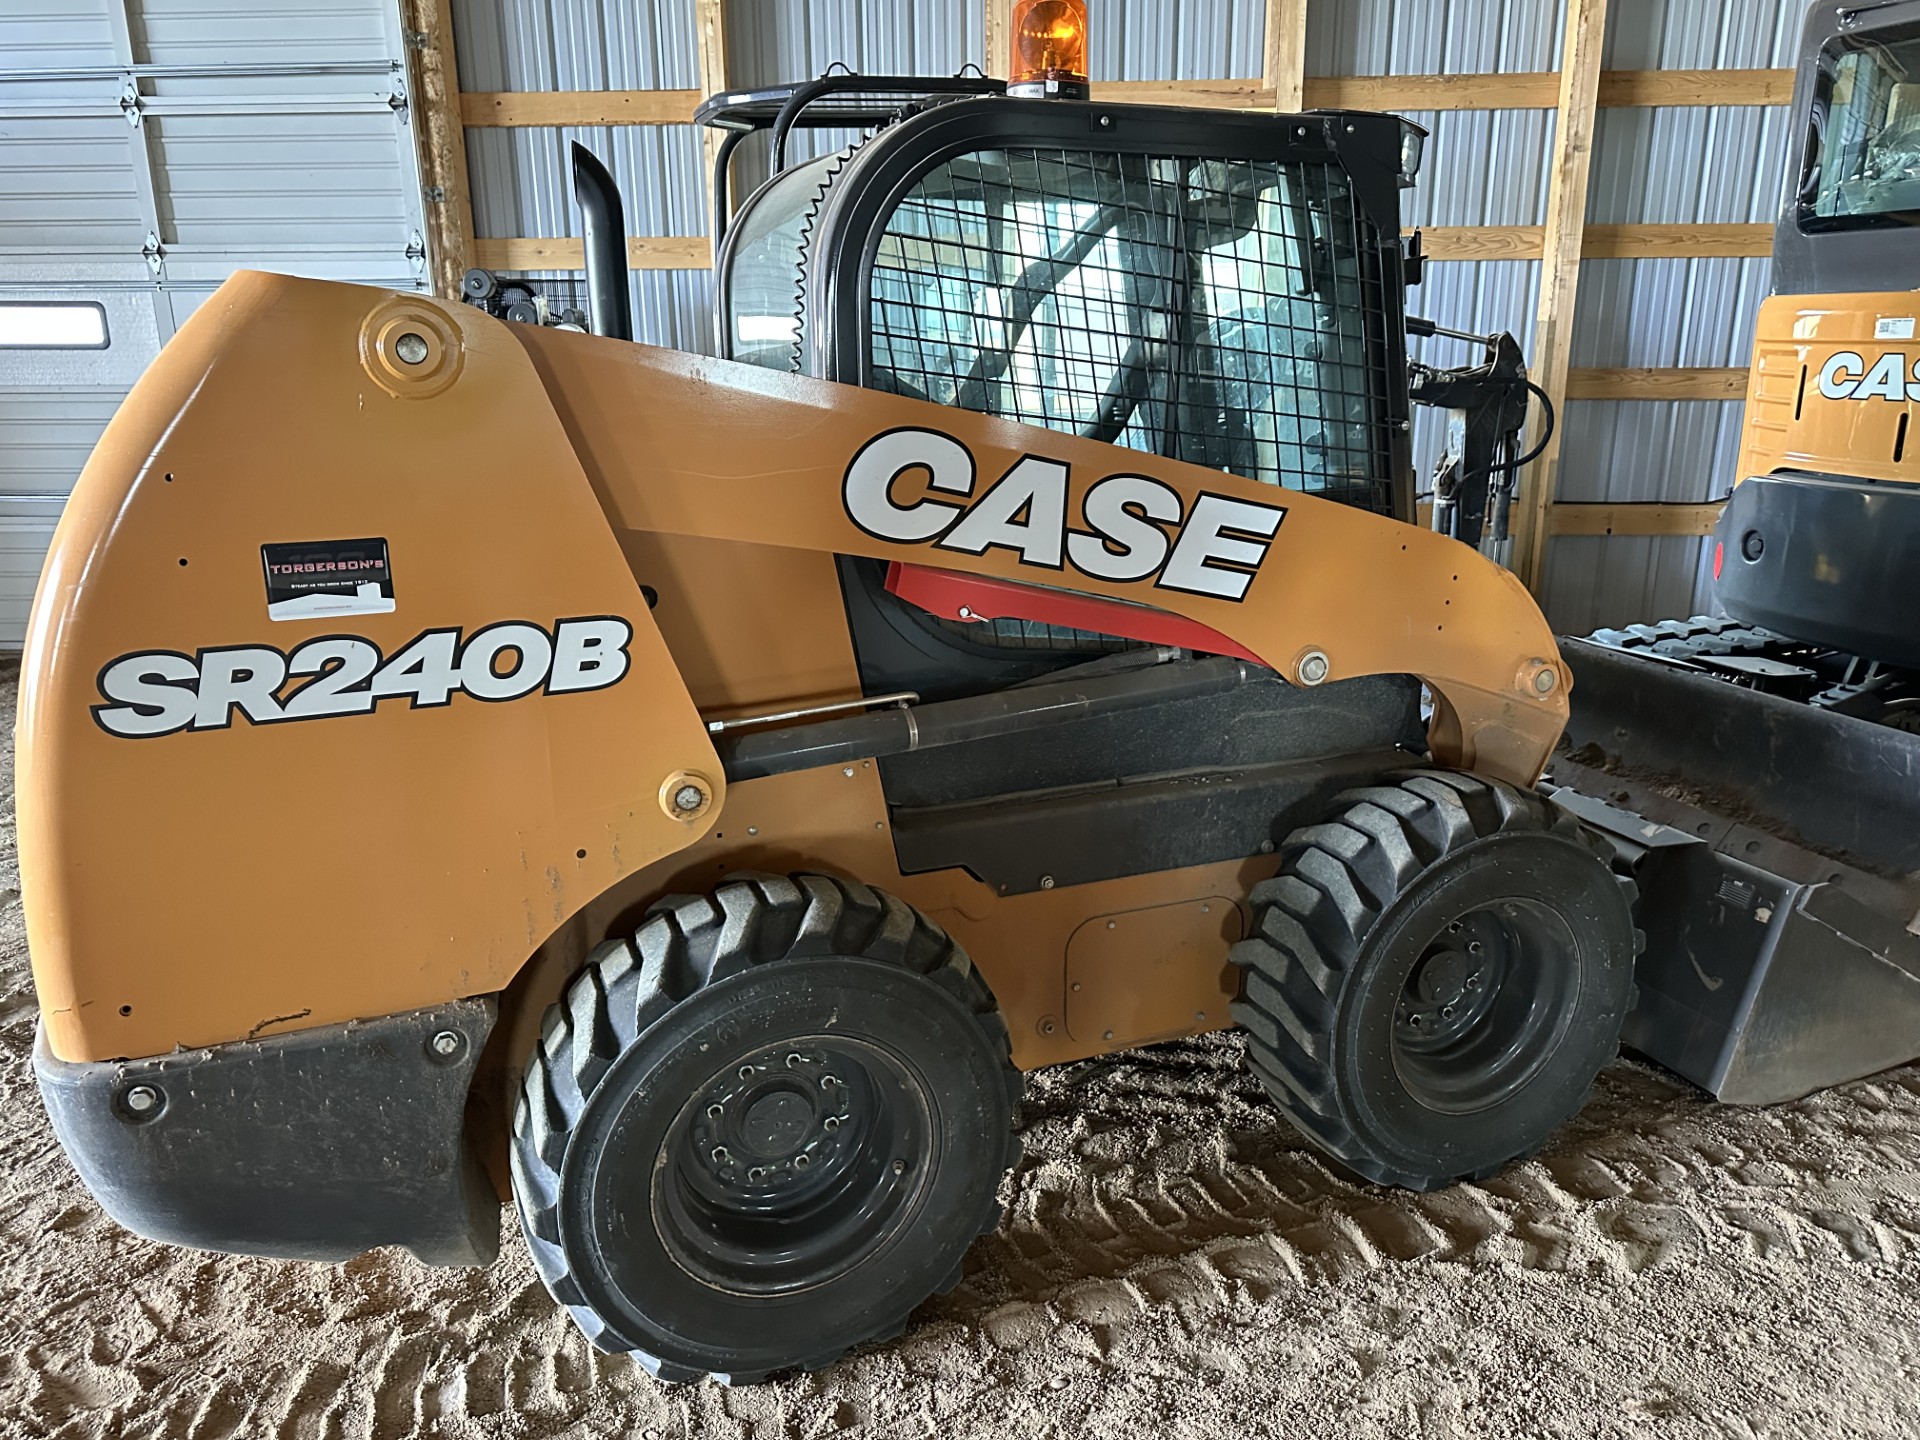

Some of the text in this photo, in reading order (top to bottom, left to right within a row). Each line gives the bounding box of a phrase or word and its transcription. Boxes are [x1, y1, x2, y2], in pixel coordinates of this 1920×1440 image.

[1818, 350, 1920, 402] CA
[841, 426, 1289, 603] CASE
[270, 559, 384, 574] TORGERSON'S
[90, 615, 634, 739] SR240B
